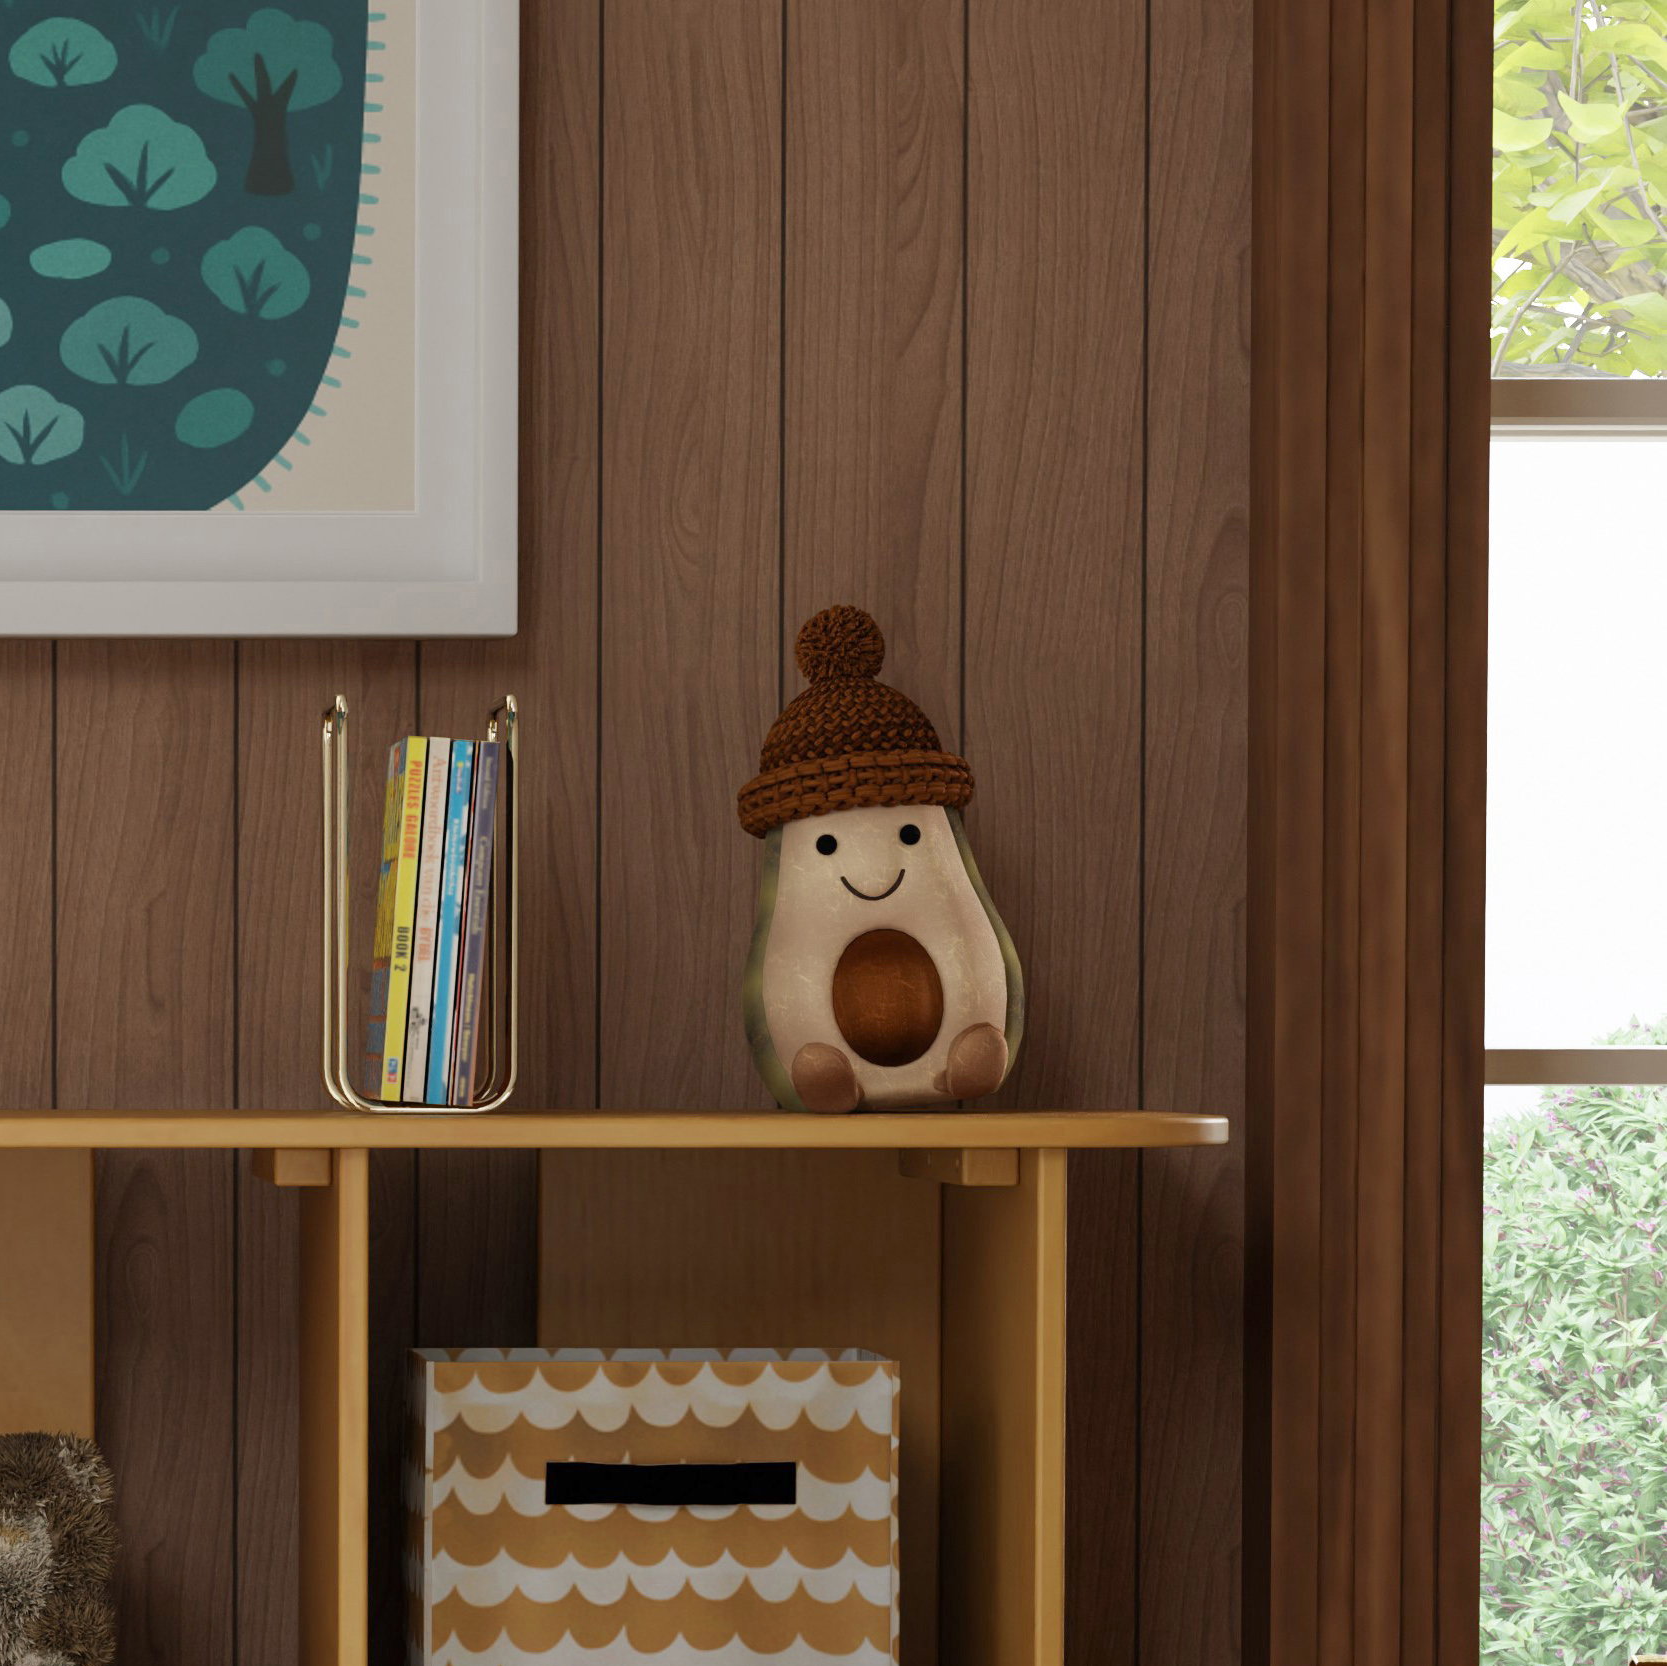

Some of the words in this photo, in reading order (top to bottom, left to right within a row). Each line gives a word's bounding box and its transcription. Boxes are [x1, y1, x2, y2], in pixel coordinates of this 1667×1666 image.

[406, 760, 422, 809] PUZZLES
[403, 815, 418, 858] GALORE
[395, 926, 410, 959] BOOK
[394, 963, 407, 972] 2
